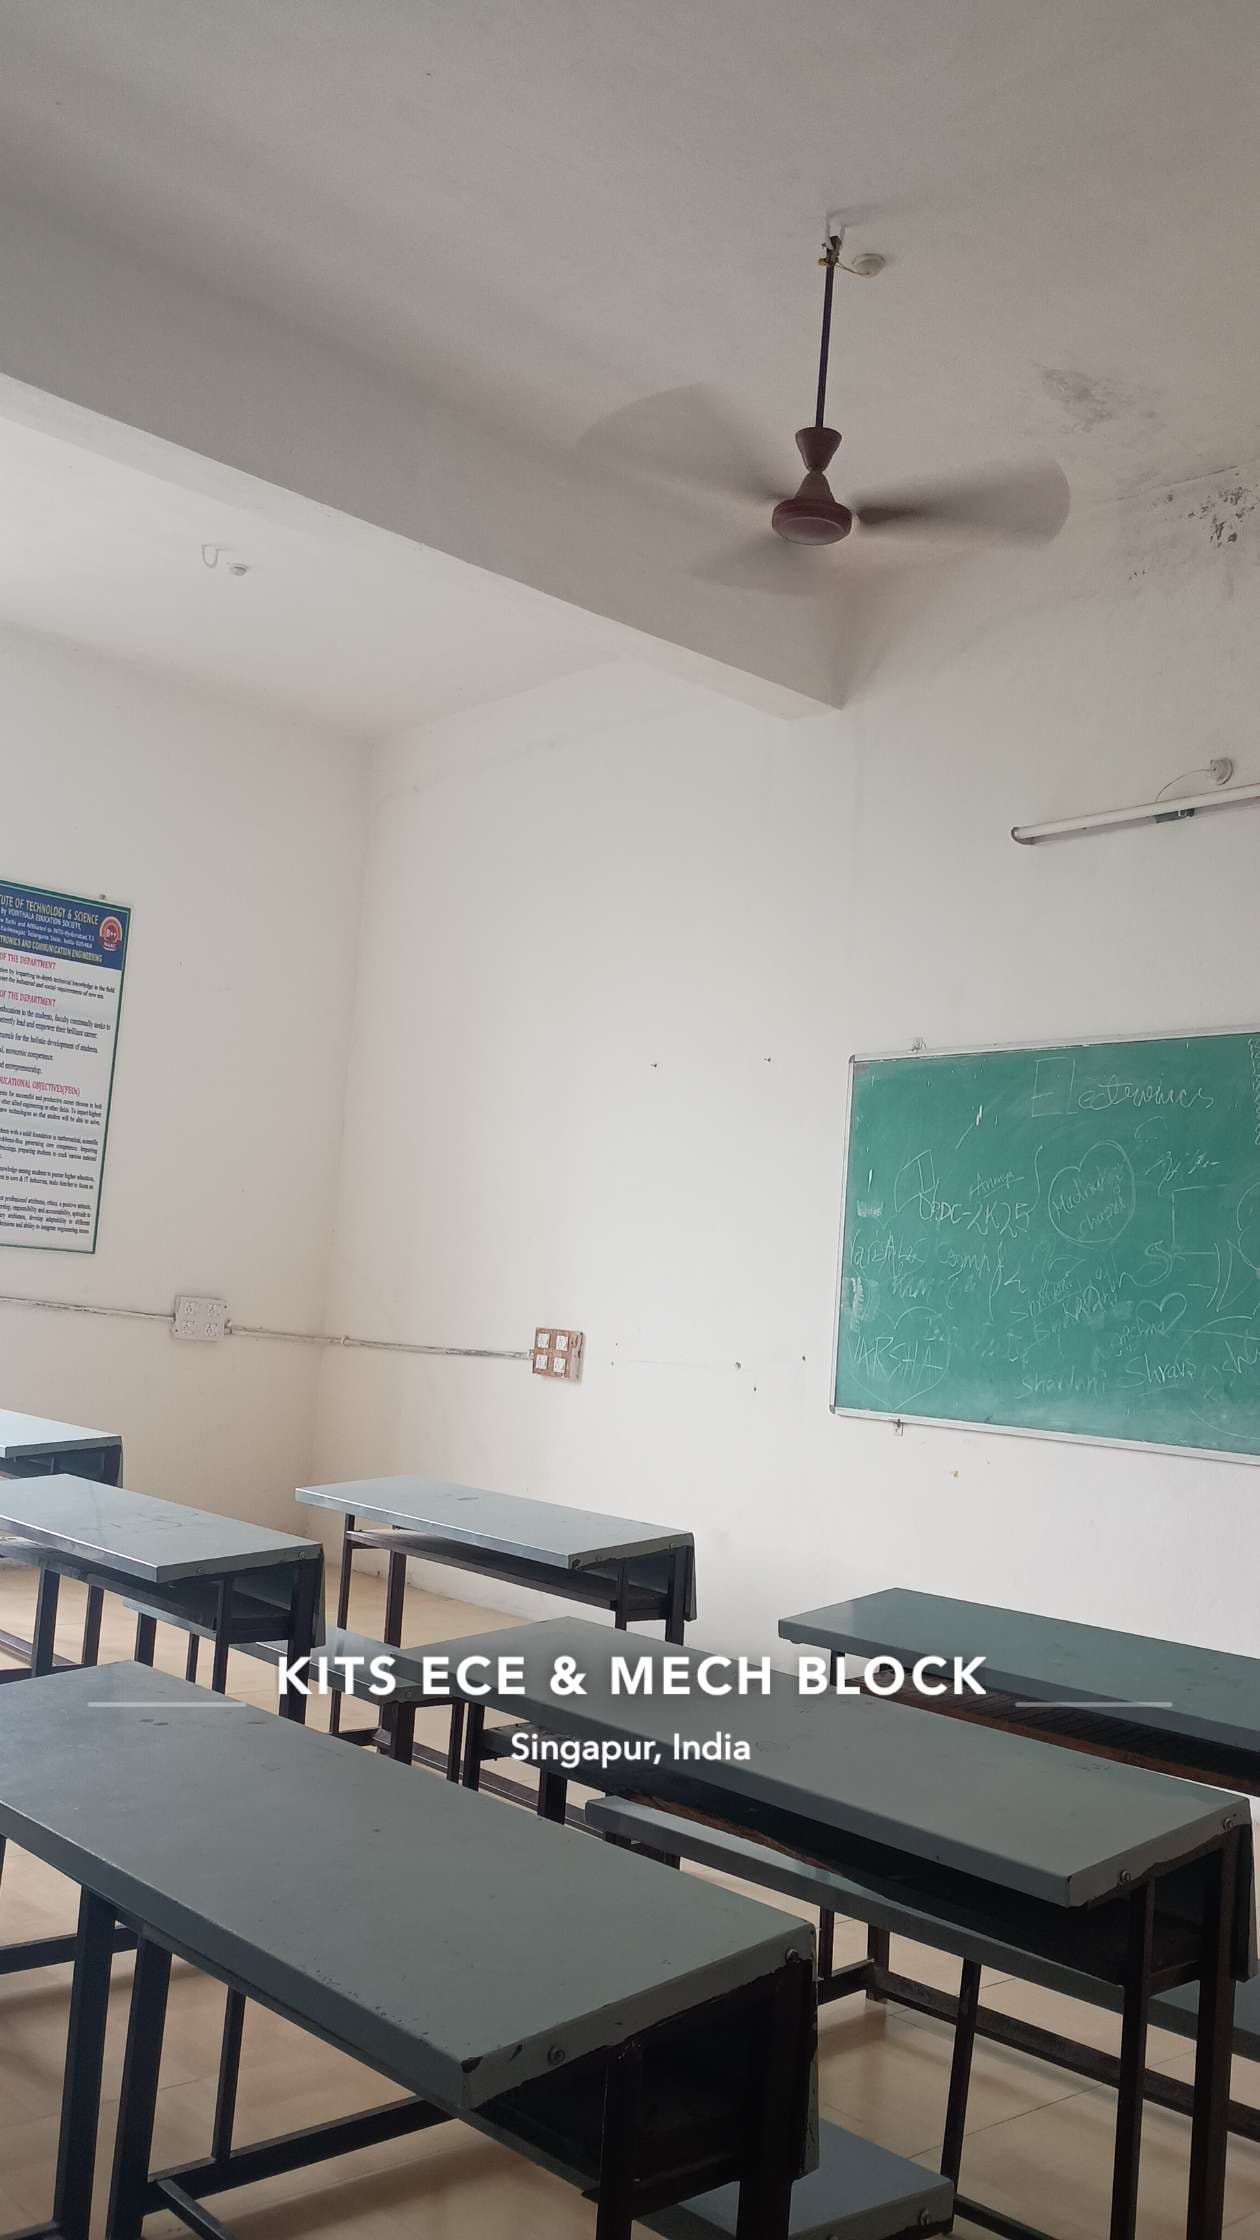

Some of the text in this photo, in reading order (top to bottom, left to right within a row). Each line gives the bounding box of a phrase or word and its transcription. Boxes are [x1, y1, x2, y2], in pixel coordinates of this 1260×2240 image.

[0, 894, 14, 907] UTE
[15, 898, 24, 910] OF
[26, 900, 65, 918] TECHNOLOGY
[74, 911, 99, 926] SCIENCE
[36, 914, 62, 926] EDUCATION
[8, 953, 19, 964] THE
[20, 955, 56, 970] DEPARTMENT
[8, 991, 19, 1001] THE
[20, 993, 56, 1008] DEPARTMENT
